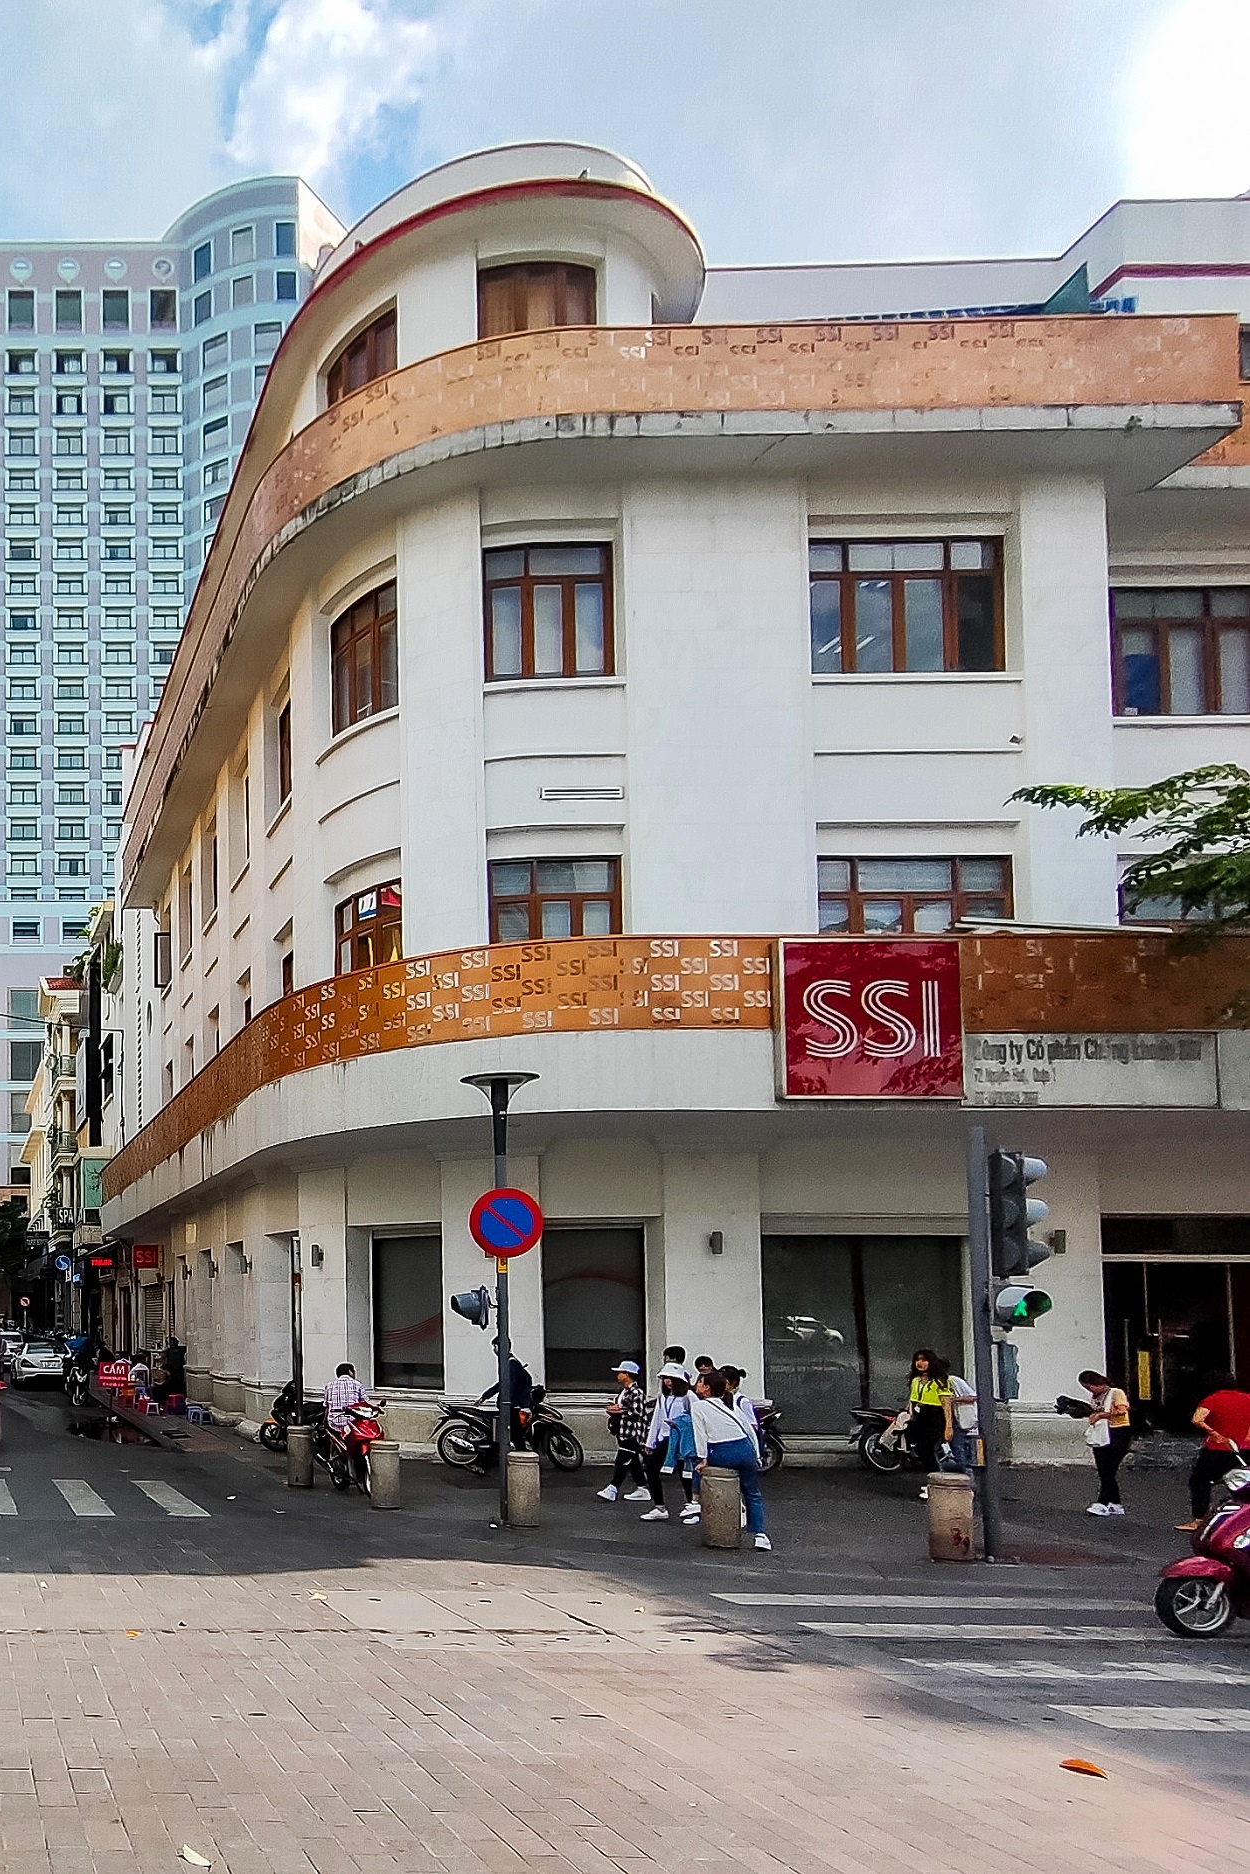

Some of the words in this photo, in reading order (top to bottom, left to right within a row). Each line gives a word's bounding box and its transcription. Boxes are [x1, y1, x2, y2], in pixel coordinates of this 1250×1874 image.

[405, 960, 431, 979] SSI
[461, 951, 490, 970] SSI
[521, 945, 551, 963] SSI
[650, 939, 679, 958] SSI
[710, 939, 738, 957] SSI
[382, 982, 405, 1000] SSI
[491, 964, 521, 982] SSI
[556, 959, 586, 977] SSI
[680, 957, 708, 975] SSI
[742, 957, 770, 975] SSI
[406, 992, 431, 1011] SSI
[461, 983, 490, 1003] SSI
[521, 977, 551, 996] SSI
[651, 974, 680, 991] SSI
[710, 974, 739, 991] SSI
[432, 1003, 460, 1022] SSI
[491, 996, 522, 1015] SSI
[556, 992, 588, 1010] SSI
[680, 990, 709, 1008] SSI
[743, 990, 771, 1008] SSI
[522, 1010, 553, 1029] SSI
[588, 1008, 618, 1025] SSI
[651, 1007, 681, 1024] SSI
[710, 1007, 740, 1025] SSI
[803, 980, 941, 1057] SSI
[58, 1210, 73, 1223] SPA
[136, 1251, 156, 1263] SSI
